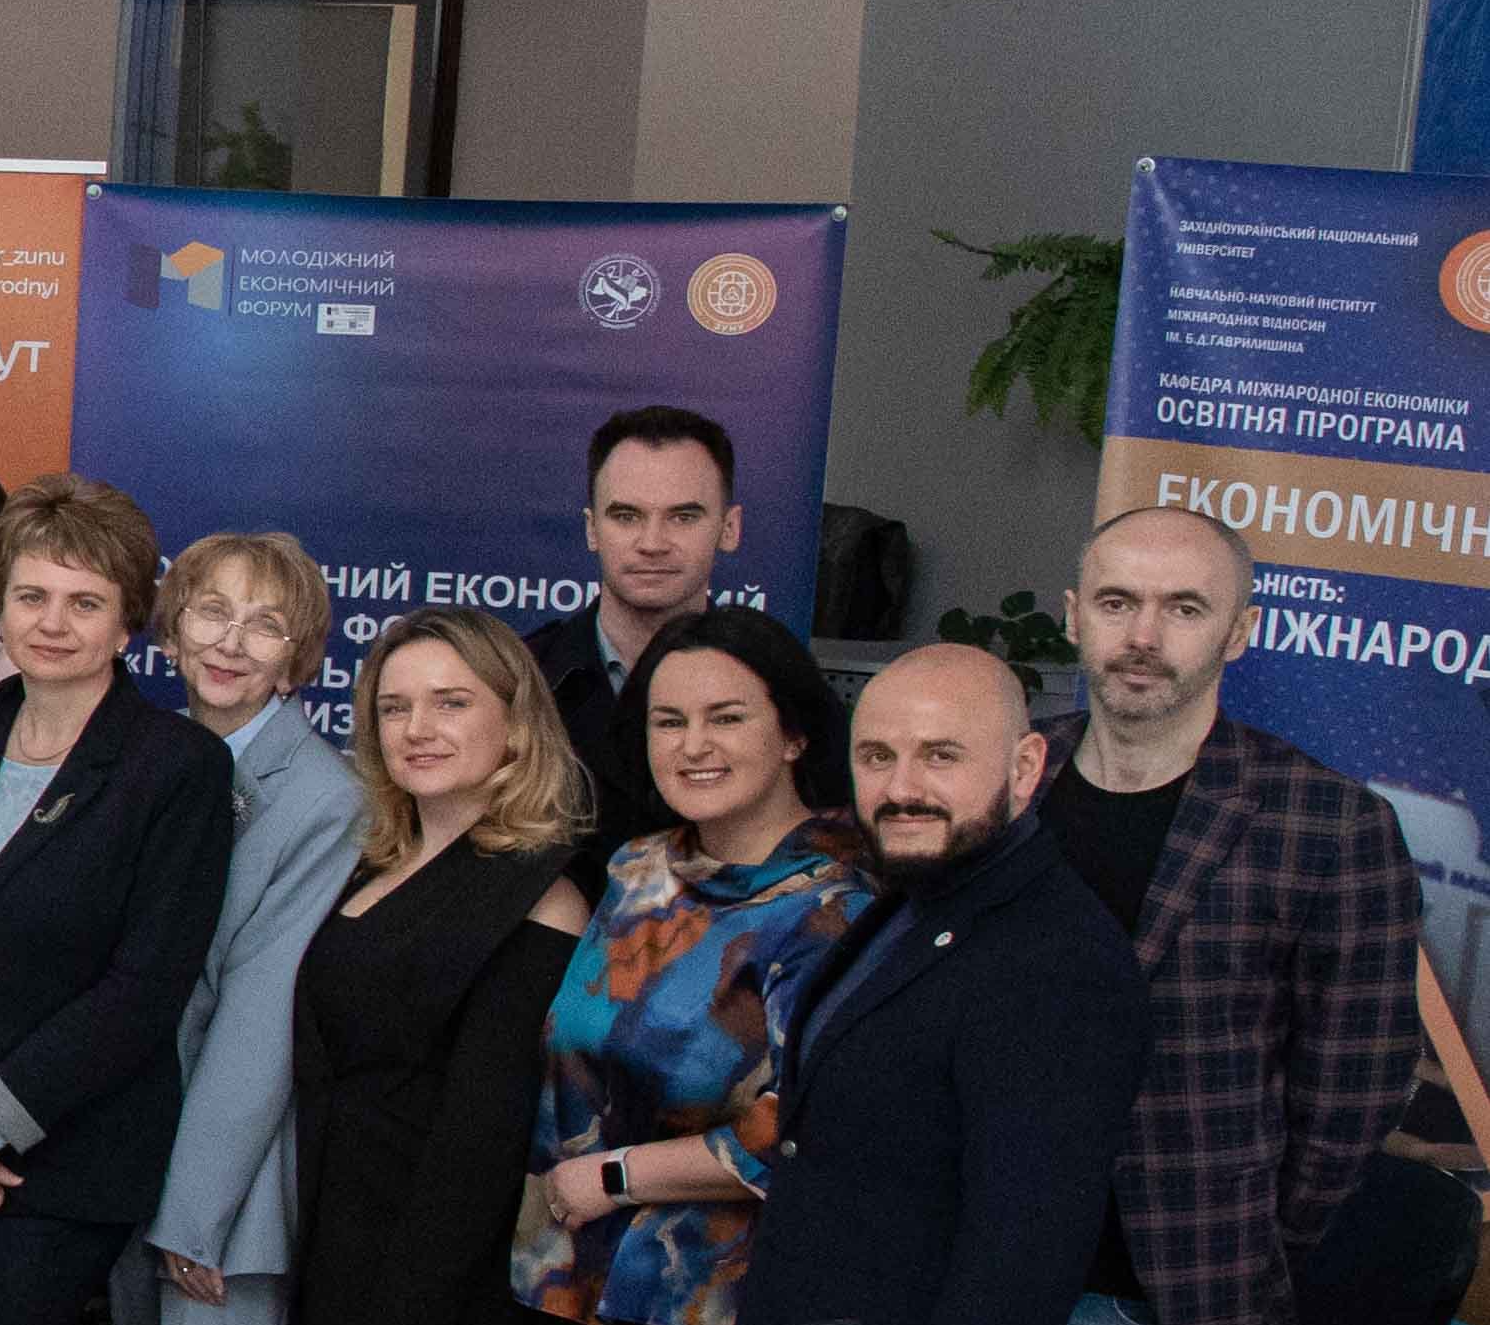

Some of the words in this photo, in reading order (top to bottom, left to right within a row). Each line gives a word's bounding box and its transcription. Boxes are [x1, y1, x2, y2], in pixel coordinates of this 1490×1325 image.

[1179, 220, 1316, 242] ЗАХІДНОУКРАЇНСЬКИЙ
[1318, 229, 1419, 247] НАЦІОНАЛЬНИЙ
[240, 248, 395, 269] МОЛОДІЖНИЙ
[1176, 243, 1256, 259] УНІВЕРСИТЕТ
[239, 275, 395, 296] ЕКОНОМІЧНИЙ
[237, 300, 312, 317] ФОРУМ
[1169, 286, 1315, 310] НАВЧАЛЬНО-НАУКОВИЙ
[1317, 297, 1376, 313] ІНСТИТУТ
[1167, 309, 1260, 327] МІЖНАРОДНИХ
[1262, 315, 1327, 333] ВІДНОСИН
[1159, 373, 1232, 394] КАФЕДРА
[1237, 379, 1361, 406] МІЖНАРОДНОЇ
[1364, 391, 1469, 416] ЕКОНОМІКИ
[1157, 396, 1287, 435] ОСВІТНЯ
[1295, 409, 1466, 452] ПРОГРАМА
[1157, 473, 1490, 558] ЕКОНОМІЧН
